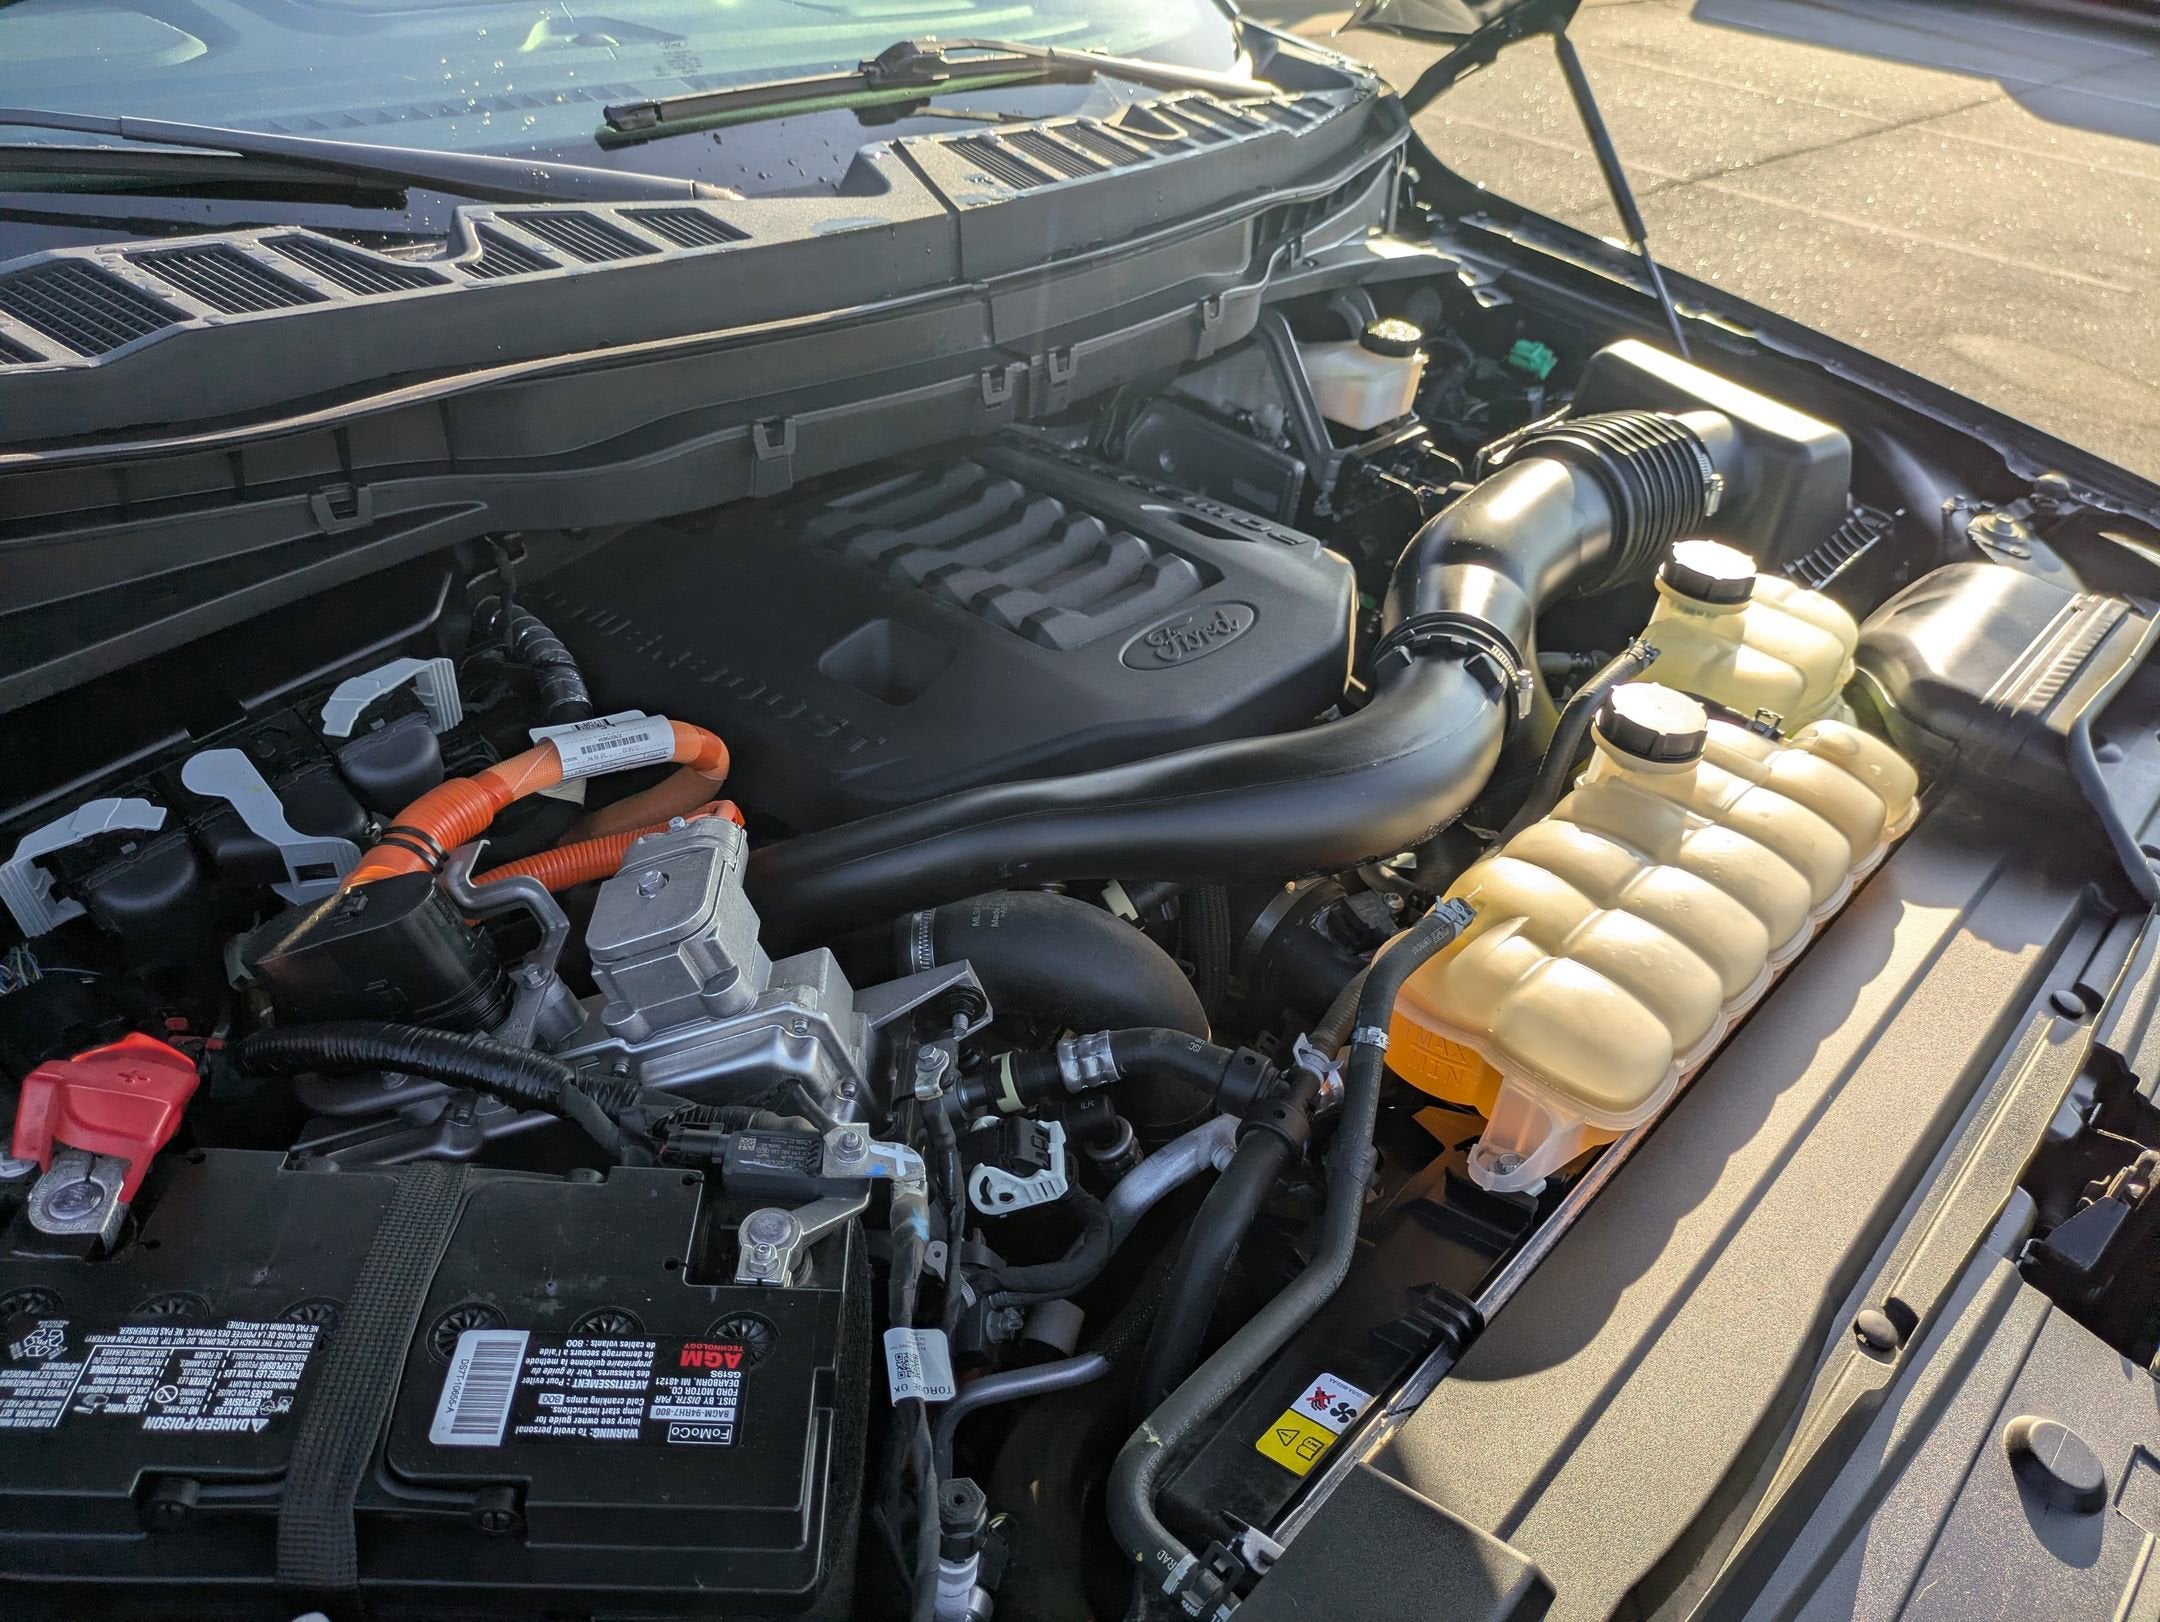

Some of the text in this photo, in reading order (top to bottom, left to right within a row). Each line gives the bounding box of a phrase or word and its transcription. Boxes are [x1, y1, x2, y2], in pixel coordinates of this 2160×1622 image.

[1144, 609, 1239, 662] Ford
[261, 1323, 270, 1331] LA
[296, 1324, 309, 1332] PAS
[310, 1324, 319, 1332] NE
[174, 1328, 184, 1336] NE
[218, 1330, 231, 1338] DES
[267, 1331, 276, 1339] DE
[277, 1332, 296, 1340] HORS
[134, 1336, 149, 1344] NOT
[149, 1336, 159, 1344] DO
[173, 1337, 187, 1345] NOT
[187, 1337, 196, 1345] DO
[240, 1339, 260, 1347] REACH
[273, 1340, 283, 1348] OF
[297, 1341, 313, 1349] KEEP
[590, 1340, 618, 1350] volants
[620, 1341, 644, 1350] cables
[646, 1342, 656, 1350] de
[684, 1343, 744, 1352] TECHNOLOGY
[570, 1349, 599, 1357] secours
[601, 1349, 642, 1359] demarrage
[645, 1351, 654, 1360] de
[525, 1357, 559, 1366] methode
[561, 1359, 568, 1367] la
[680, 1350, 742, 1369] AGM
[258, 1361, 291, 1370] EXPLOSIFS
[290, 1362, 304, 1371] GAZ
[223, 1369, 236, 1378] LES
[237, 1370, 254, 1378] YEUX
[255, 1370, 267, 1378] LES
[530, 1367, 650, 1378] des blessures. Voir le guide du
[710, 1370, 741, 1379] G519S
[144, 1378, 154, 1386] OR
[177, 1376, 189, 1384] LES
[546, 1377, 564, 1386] Pour
[571, 1379, 649, 1390] AVERTISSEMENT
[656, 1377, 739, 1387] DEARBORN, MI 48121
[252, 1381, 262, 1389] OR
[263, 1382, 297, 1390] BLINDNESS
[894, 1384, 909, 1393] OK
[136, 1386, 150, 1394] CAN
[237, 1389, 250, 1397] CAN
[250, 1390, 273, 1399] GASES
[670, 1386, 738, 1397] FORD MOTOR CO.
[126, 1395, 147, 1403] ACID
[222, 1398, 261, 1407] EXPLOSIVE
[566, 1396, 588, 1405] amps
[590, 1396, 625, 1406] cranking
[627, 1397, 645, 1407] Cold
[655, 1395, 737, 1406] DIST. BY DISTR. PAR
[103, 1404, 142, 1413] SULFURIC
[189, 1406, 200, 1415] NO
[214, 1406, 258, 1416] SHIELD EYES
[549, 1406, 643, 1417] jump start instructions.
[143, 1417, 251, 1431] DANGER/POISON
[534, 1415, 641, 1427] injury see owner guide for
[515, 1425, 639, 1439] WARNING: To avoid personal
[671, 1427, 730, 1440] FoMoCo
[1157, 1550, 1178, 1570] RAD
